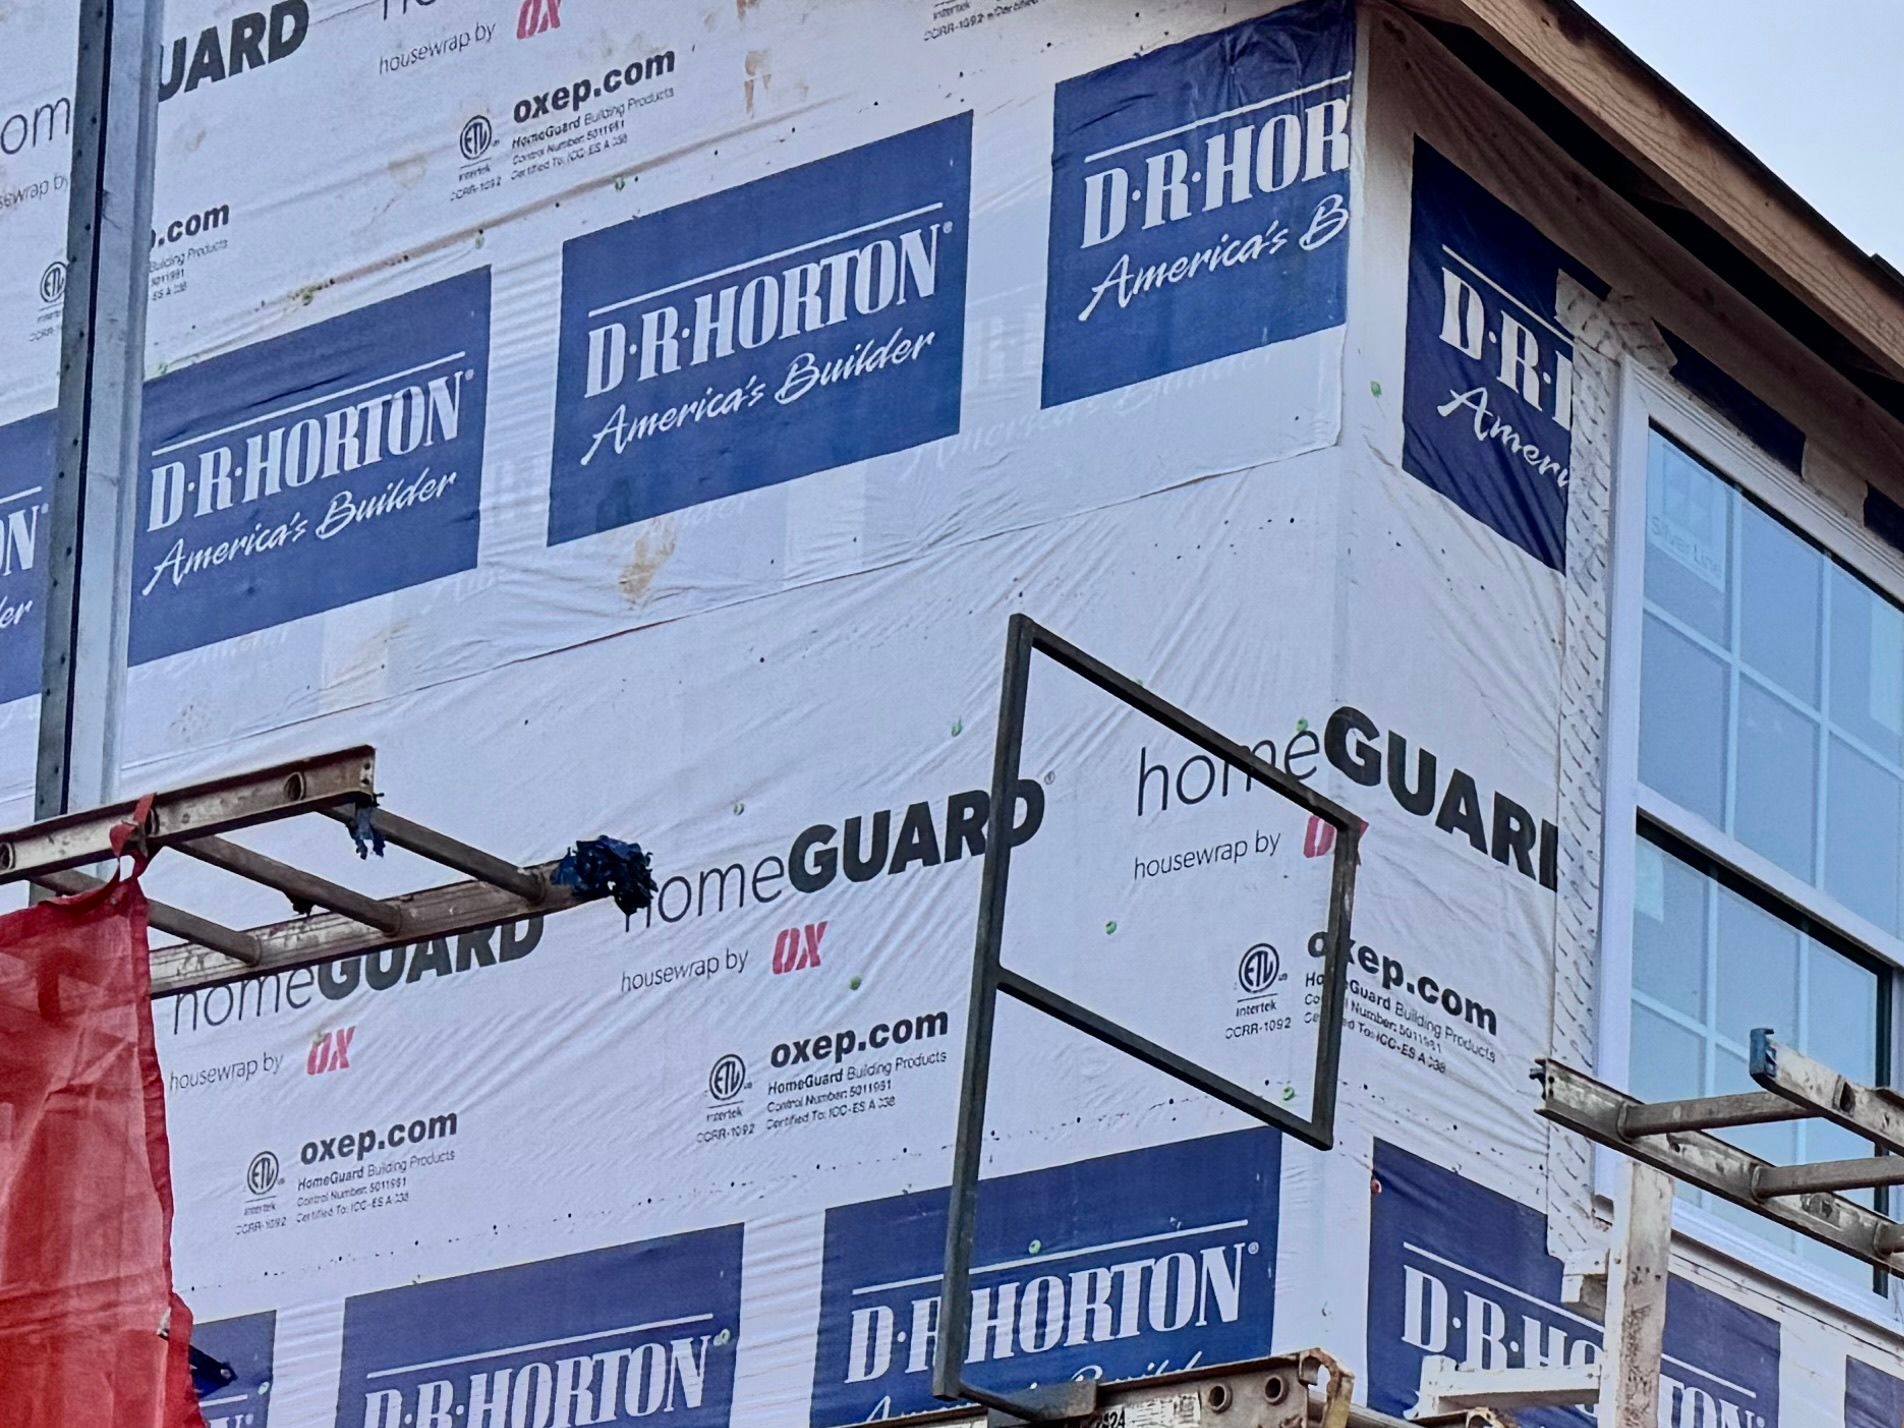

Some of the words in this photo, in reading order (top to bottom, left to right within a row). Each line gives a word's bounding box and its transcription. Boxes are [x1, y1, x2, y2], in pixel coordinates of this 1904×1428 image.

[379, 28, 471, 75] housewrap
[475, 21, 498, 44] by
[513, 50, 676, 123] oxep.com
[149, 204, 230, 250] .com
[1077, 220, 1289, 321] America's
[581, 375, 767, 466] America's
[774, 327, 936, 404] Builder
[141, 510, 307, 597] America's
[315, 468, 458, 540] Builder
[1134, 839, 1249, 881] housewrap
[1254, 829, 1282, 861] by
[621, 957, 720, 993] housewrap
[725, 947, 750, 975] by
[771, 920, 829, 976] OX
[1224, 1015, 1292, 1040] CCRR-1092
[1235, 999, 1278, 1018] Intertek
[1395, 1001, 1443, 1040] Building
[1444, 1026, 1497, 1064] Products
[169, 1058, 258, 1093] housewrap
[262, 1051, 284, 1076] by
[305, 1025, 356, 1076] OX
[770, 1010, 949, 1069] oxep.com
[767, 1067, 844, 1096] HomeGuard
[847, 1060, 893, 1082] Building
[895, 1050, 948, 1071] Products
[299, 1111, 458, 1166] oxep.com
[297, 1166, 365, 1191] HomeGuard
[409, 1150, 456, 1169] Products
